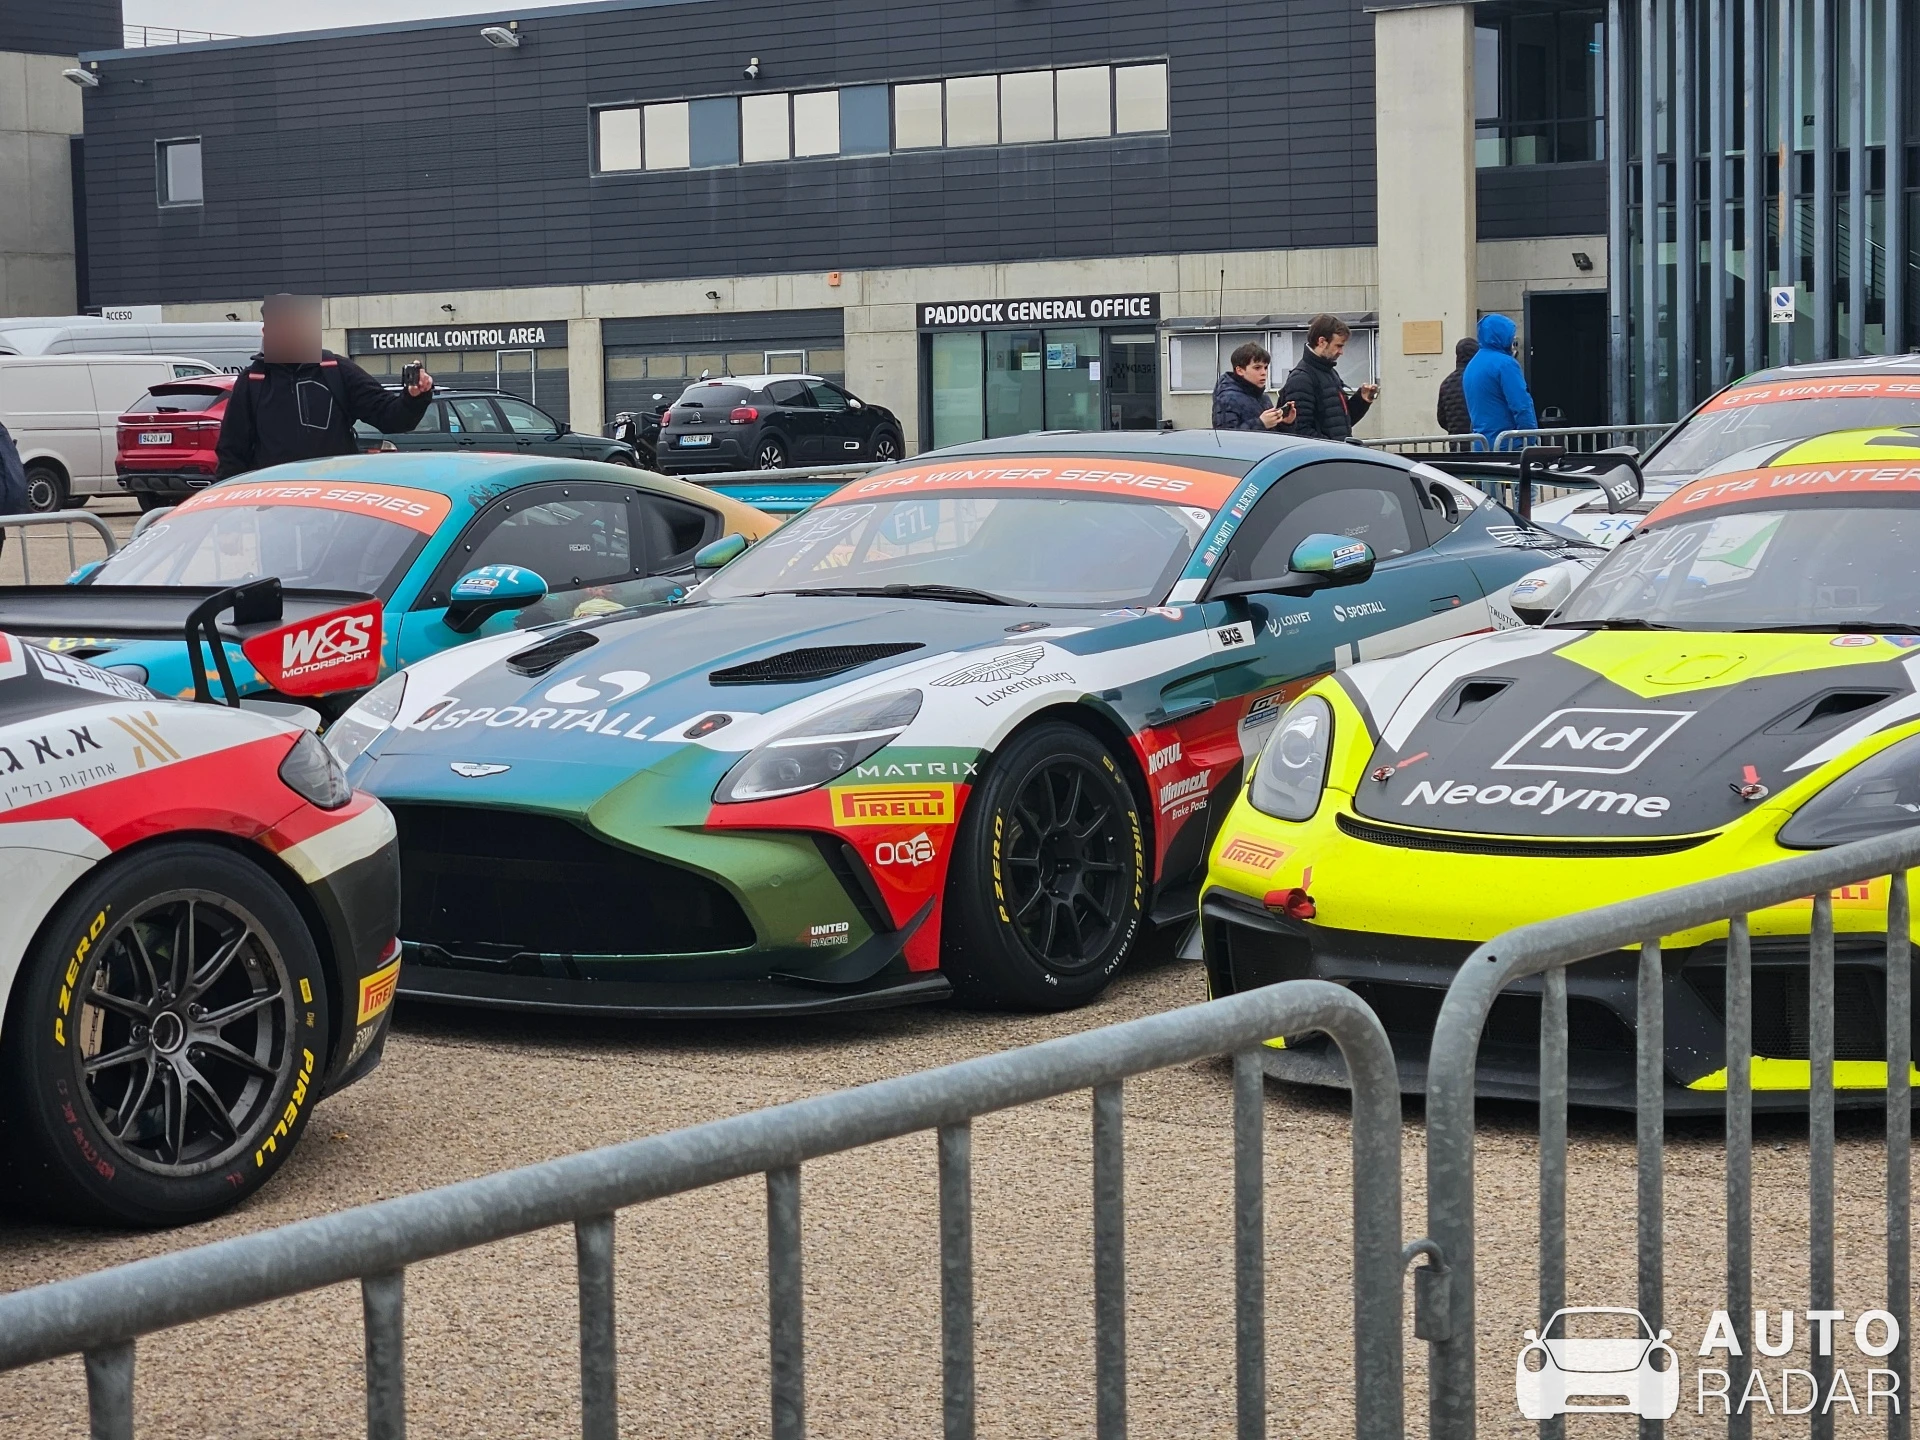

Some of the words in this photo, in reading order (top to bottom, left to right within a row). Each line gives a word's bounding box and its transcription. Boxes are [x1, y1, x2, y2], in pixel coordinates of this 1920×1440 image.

[105, 310, 133, 321] ACCESO
[924, 303, 1004, 324] PADDOCK
[1008, 299, 1086, 321] GENERAL
[1090, 297, 1151, 318] OFFICE
[371, 331, 441, 349] TECHNICAL
[445, 328, 506, 347] CONTROL
[508, 326, 546, 343] AREA
[1722, 390, 1773, 406] GT4
[1778, 383, 1882, 397] WINTER
[857, 474, 921, 494] GT4
[924, 468, 1053, 483] WINTER
[1054, 468, 1194, 492] SERIES
[1609, 480, 1638, 501] HRX
[1683, 477, 1760, 505] GT4
[223, 486, 320, 502] WINTER
[320, 488, 431, 518] SERIES
[568, 544, 592, 552] RECARO
[477, 565, 520, 585] ETL
[1280, 611, 1312, 627] LOUYET
[1346, 600, 1387, 619] SPORTALL
[282, 614, 374, 669] W&S
[282, 650, 371, 679] MOTORSPORT
[971, 663, 993, 677] ASTON
[993, 656, 1022, 672] MARTIN
[974, 671, 1077, 707] Luxembourg
[431, 705, 656, 741] SPORTALL
[1539, 725, 1649, 751] Nd
[856, 762, 979, 778] MATRIX
[1148, 742, 1183, 775] MOTUL
[840, 790, 945, 819] PIRELLI
[1172, 805, 1190, 820] Brake
[1190, 797, 1208, 813] Pads
[1401, 780, 1671, 818] Neodyme
[1127, 810, 1144, 911] PIRELLI
[1222, 838, 1285, 870] PIRELLI
[810, 934, 849, 948] RACING
[811, 921, 850, 936] UNITED
[255, 1048, 314, 1168] PIRELLI
